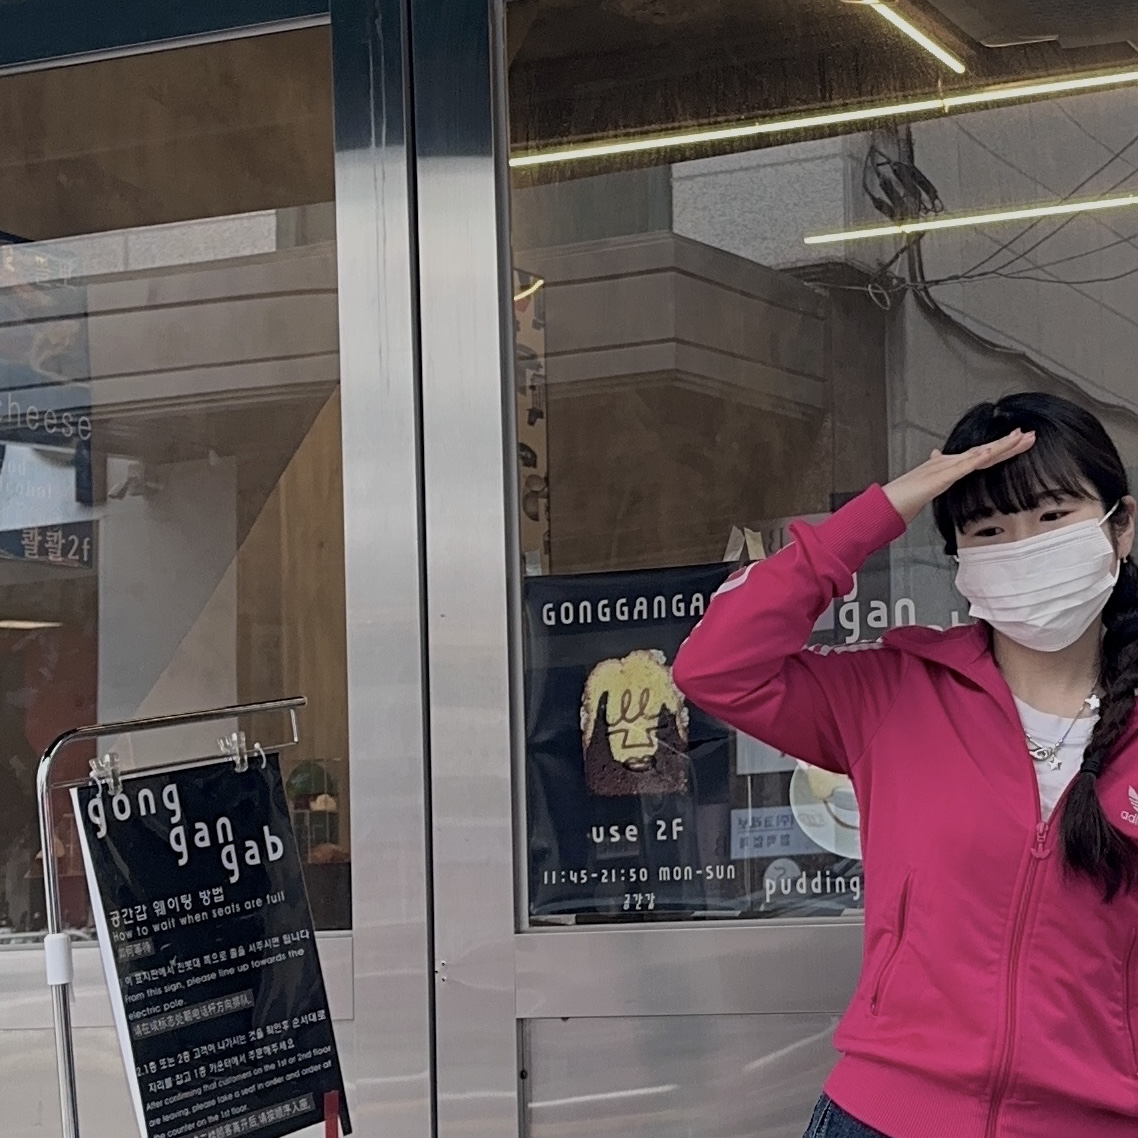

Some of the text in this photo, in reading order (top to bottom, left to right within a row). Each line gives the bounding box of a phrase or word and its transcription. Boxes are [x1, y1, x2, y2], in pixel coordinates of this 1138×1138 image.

[0, 391, 92, 440] heese
[542, 591, 716, 625] GONGGANGA
[838, 598, 916, 644] gan
[87, 783, 182, 839] gong
[592, 817, 684, 843] use 2F
[169, 816, 234, 867] gan
[220, 825, 284, 884] gab
[544, 867, 648, 884] 11:45-21:50
[765, 870, 861, 903] pudding
[109, 886, 225, 928] 공간갑 웨이팅 방법
[112, 890, 285, 942] How to wait when seats are full
